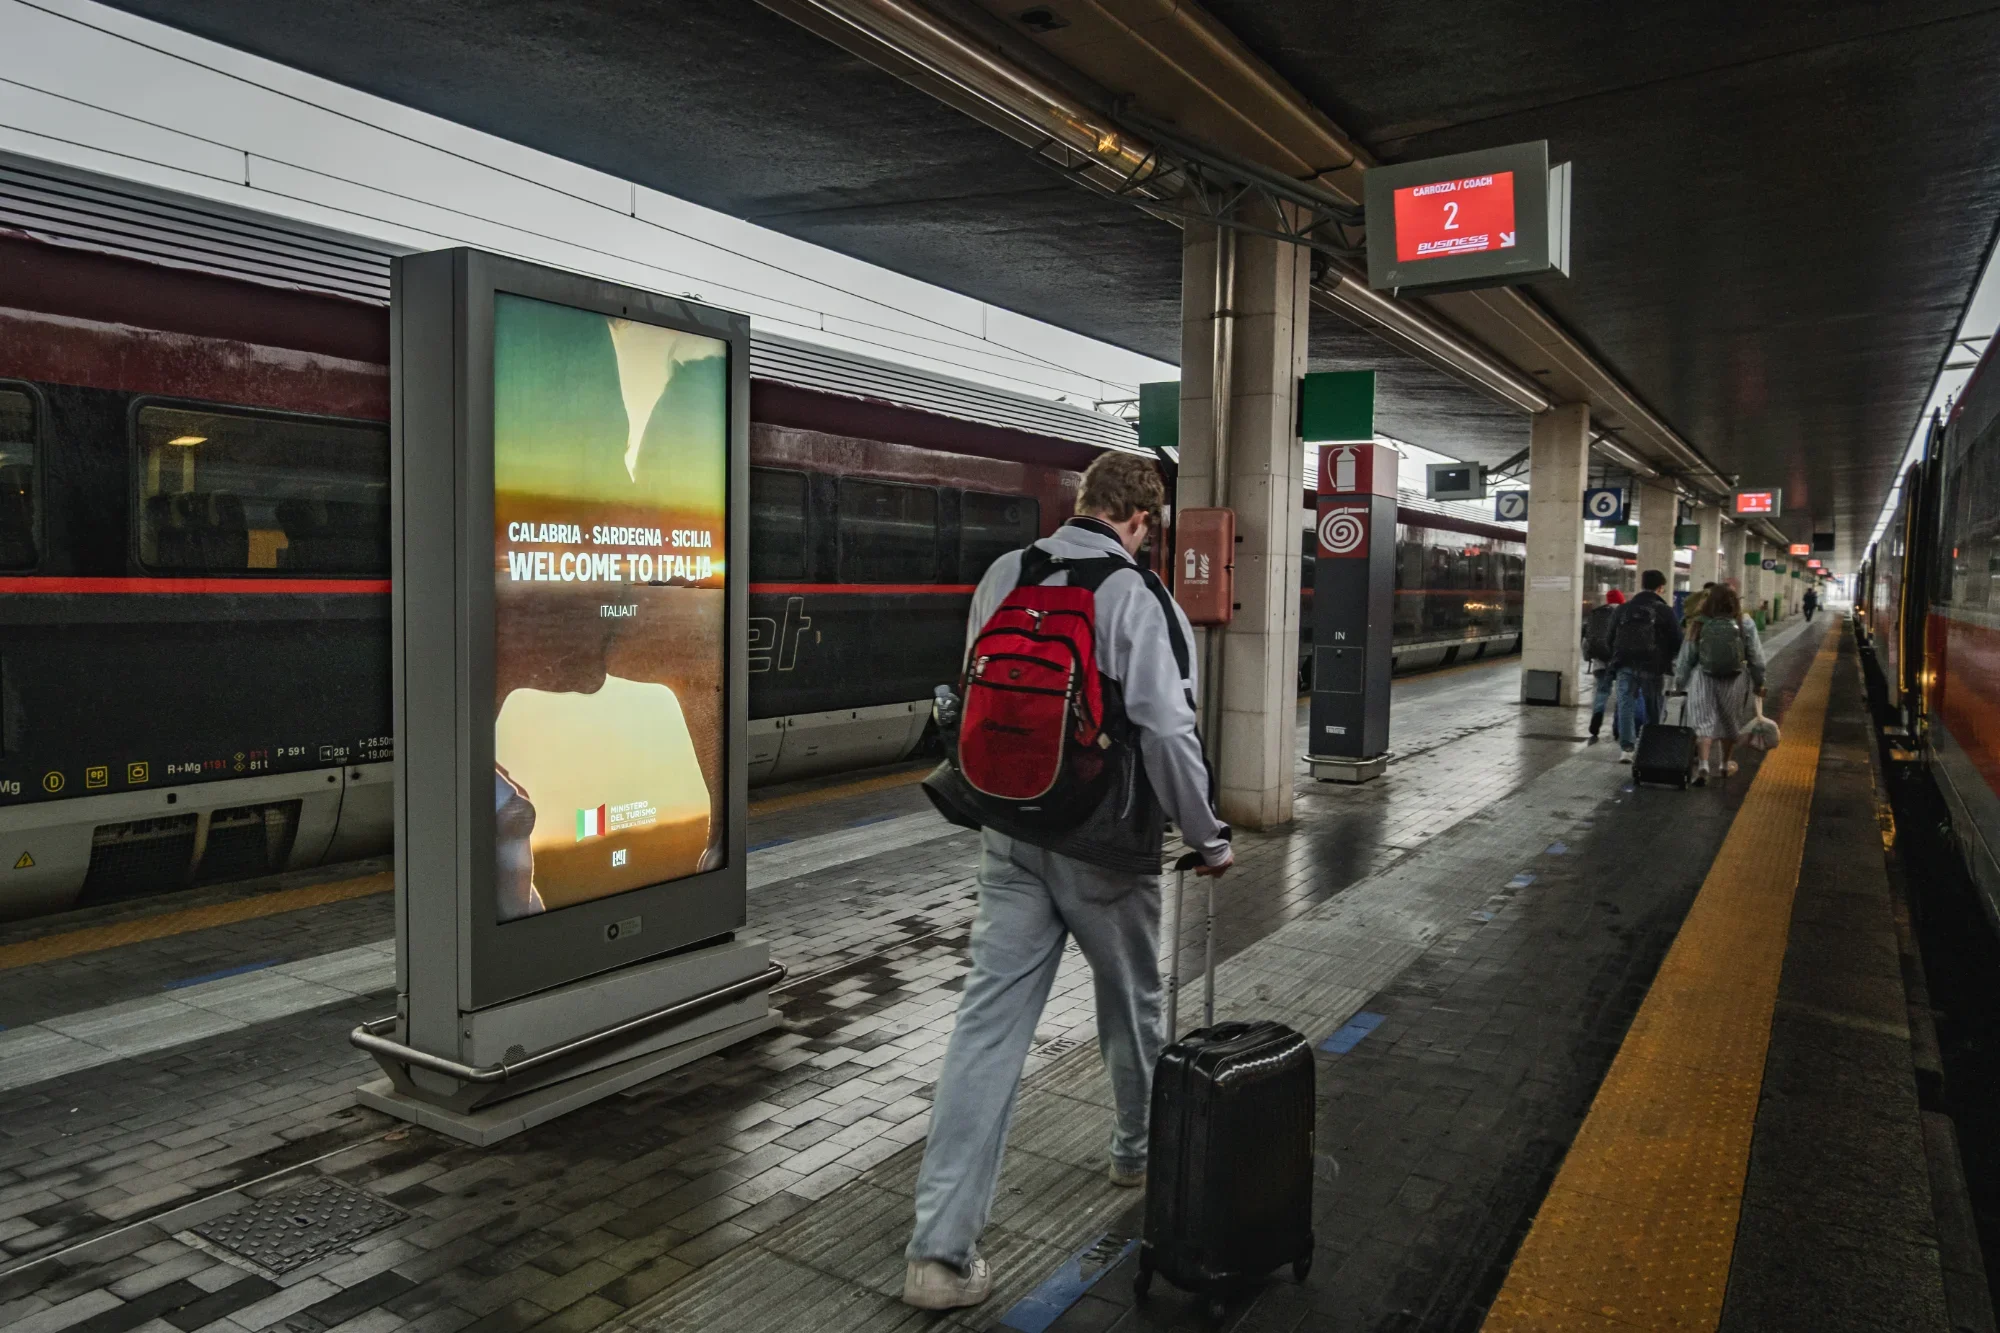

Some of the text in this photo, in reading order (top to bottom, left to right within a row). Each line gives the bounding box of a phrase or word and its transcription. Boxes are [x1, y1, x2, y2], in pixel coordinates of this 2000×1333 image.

[1413, 182, 1456, 197] CARROZZA
[1463, 176, 1493, 189] COACH
[1443, 201, 1460, 230] 2
[1418, 234, 1489, 251] BUSINESS
[1505, 498, 1519, 514] 7
[1596, 496, 1611, 513] 6
[508, 521, 712, 548] CALABRIA SARDEGNA SICILIA
[508, 551, 713, 582] WELCOME TO ITALIA
[1334, 631, 1346, 641] IN
[288, 746, 300, 756] 59
[333, 747, 345, 757] 28
[90, 769, 104, 779] ep
[611, 800, 648, 814] MINISTERO
[611, 807, 657, 823] DEL TURISMO
